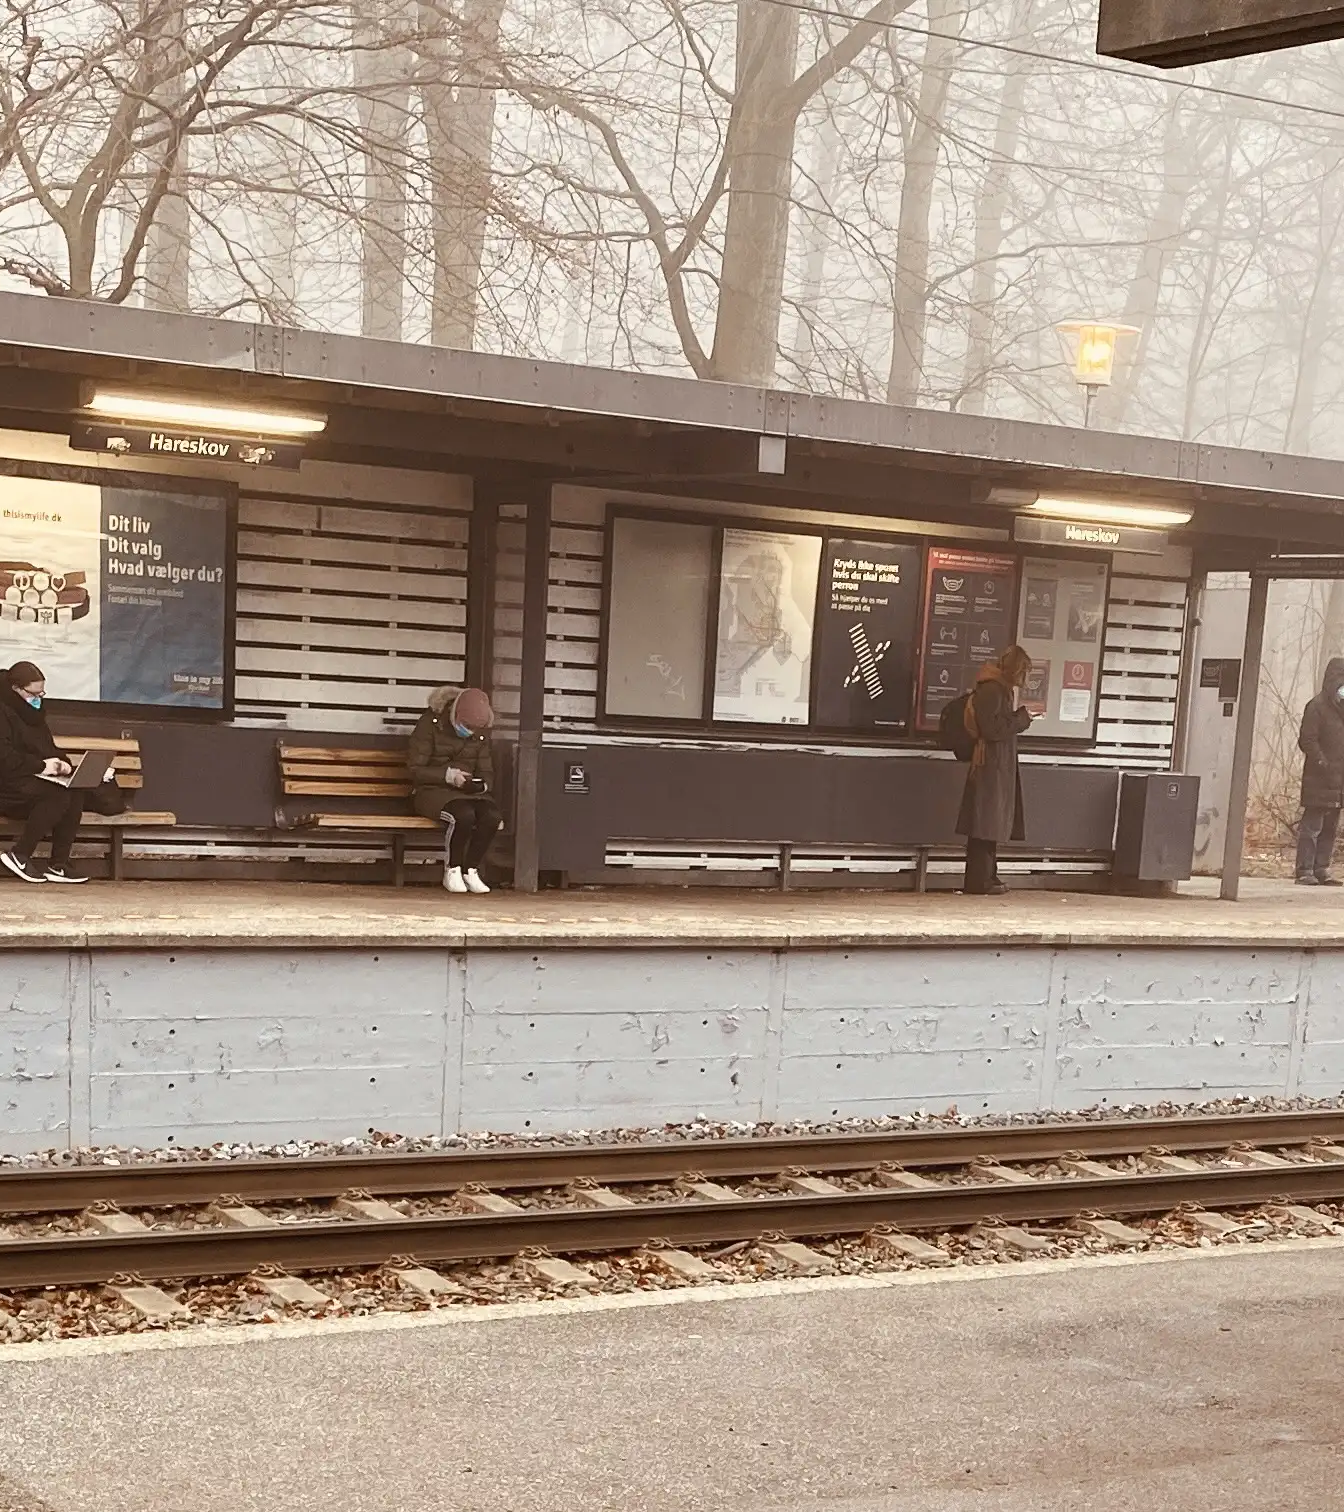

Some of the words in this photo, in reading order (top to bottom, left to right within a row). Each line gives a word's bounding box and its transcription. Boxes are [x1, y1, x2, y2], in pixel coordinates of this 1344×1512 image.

[149, 433, 230, 457] Hareskov
[3, 509, 62, 523] thisismylifedk
[108, 514, 130, 533] Dit
[132, 516, 151, 534] liv
[1065, 524, 1120, 544] Hareskov
[108, 536, 129, 554] Dit
[131, 539, 163, 561] valg
[108, 558, 144, 577] Hvad
[147, 562, 196, 584] vælger
[197, 565, 224, 583] du?
[833, 558, 857, 571] Kryds
[850, 571, 862, 580] du
[831, 581, 859, 591] perron
